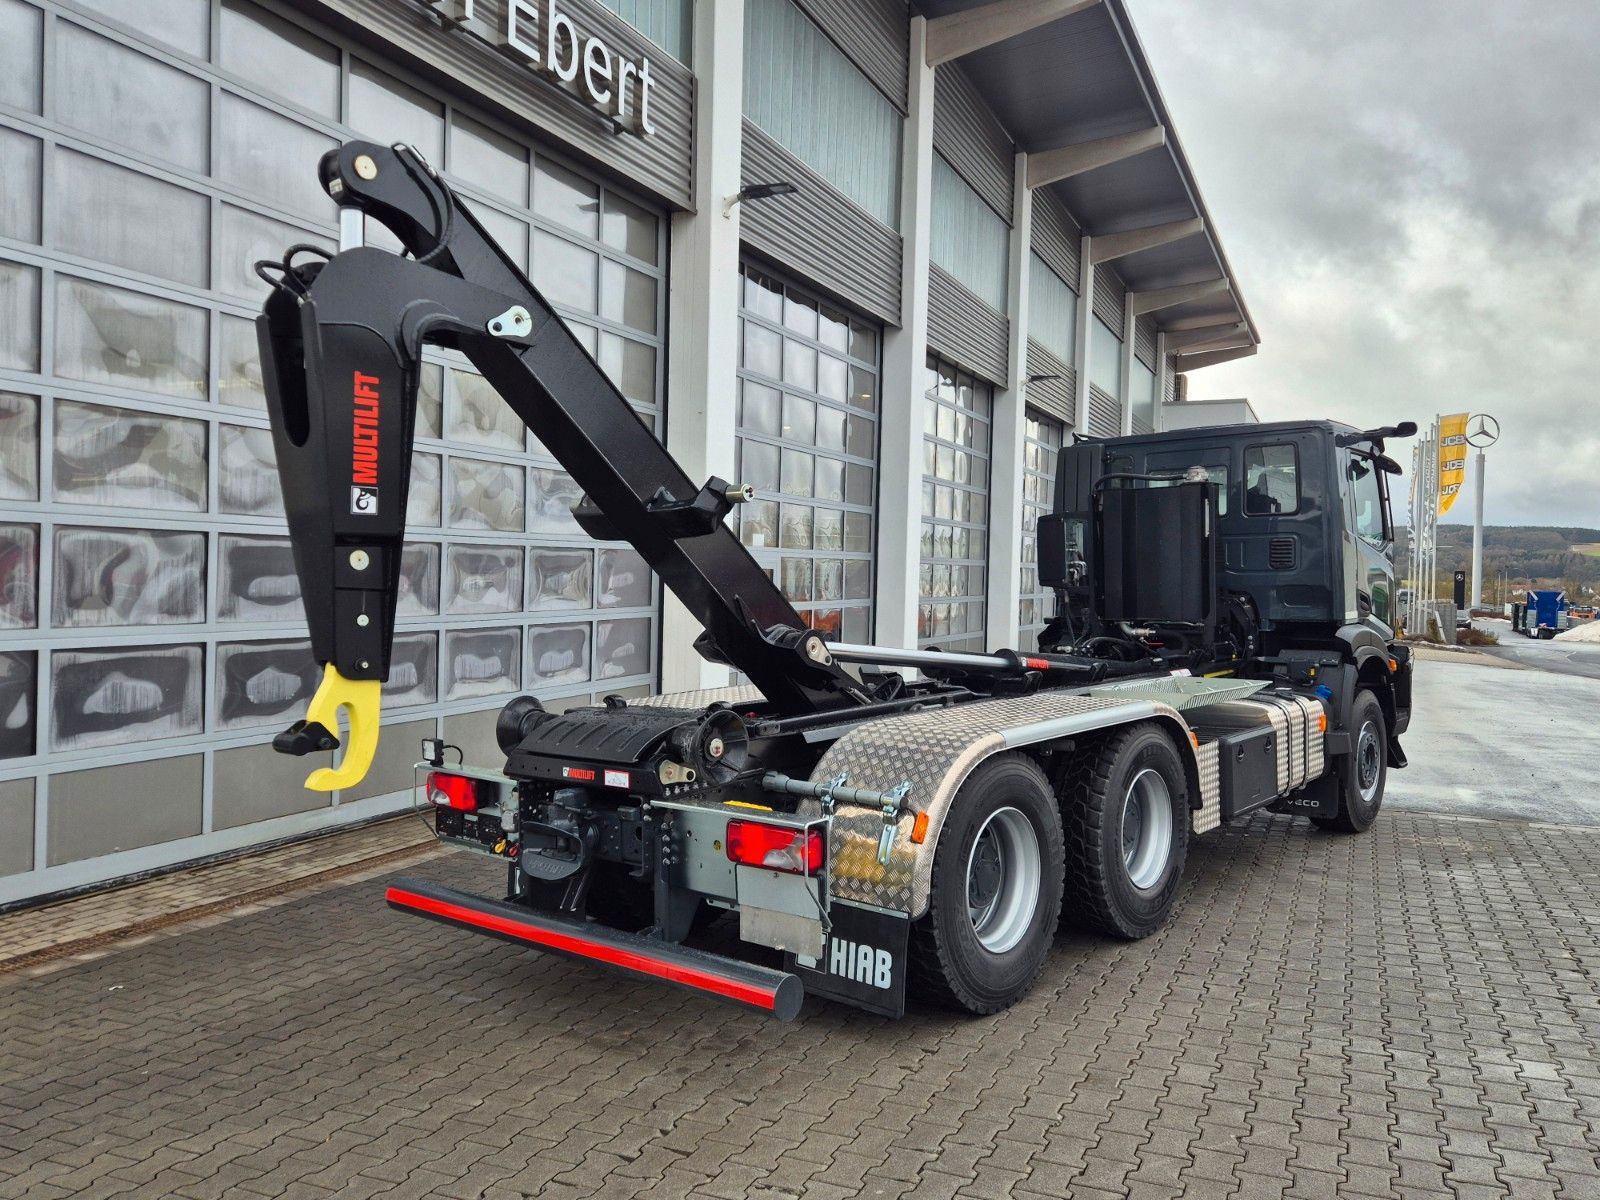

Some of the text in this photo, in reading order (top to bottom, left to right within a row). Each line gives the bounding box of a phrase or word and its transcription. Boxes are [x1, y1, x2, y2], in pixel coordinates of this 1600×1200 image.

[508, 0, 655, 135] Ebert
[352, 370, 380, 485] MULTILIFT
[1441, 433, 1466, 447] JCB
[1442, 459, 1464, 472] JCB
[1286, 799, 1319, 807] VECO
[830, 937, 893, 990] HIAB
